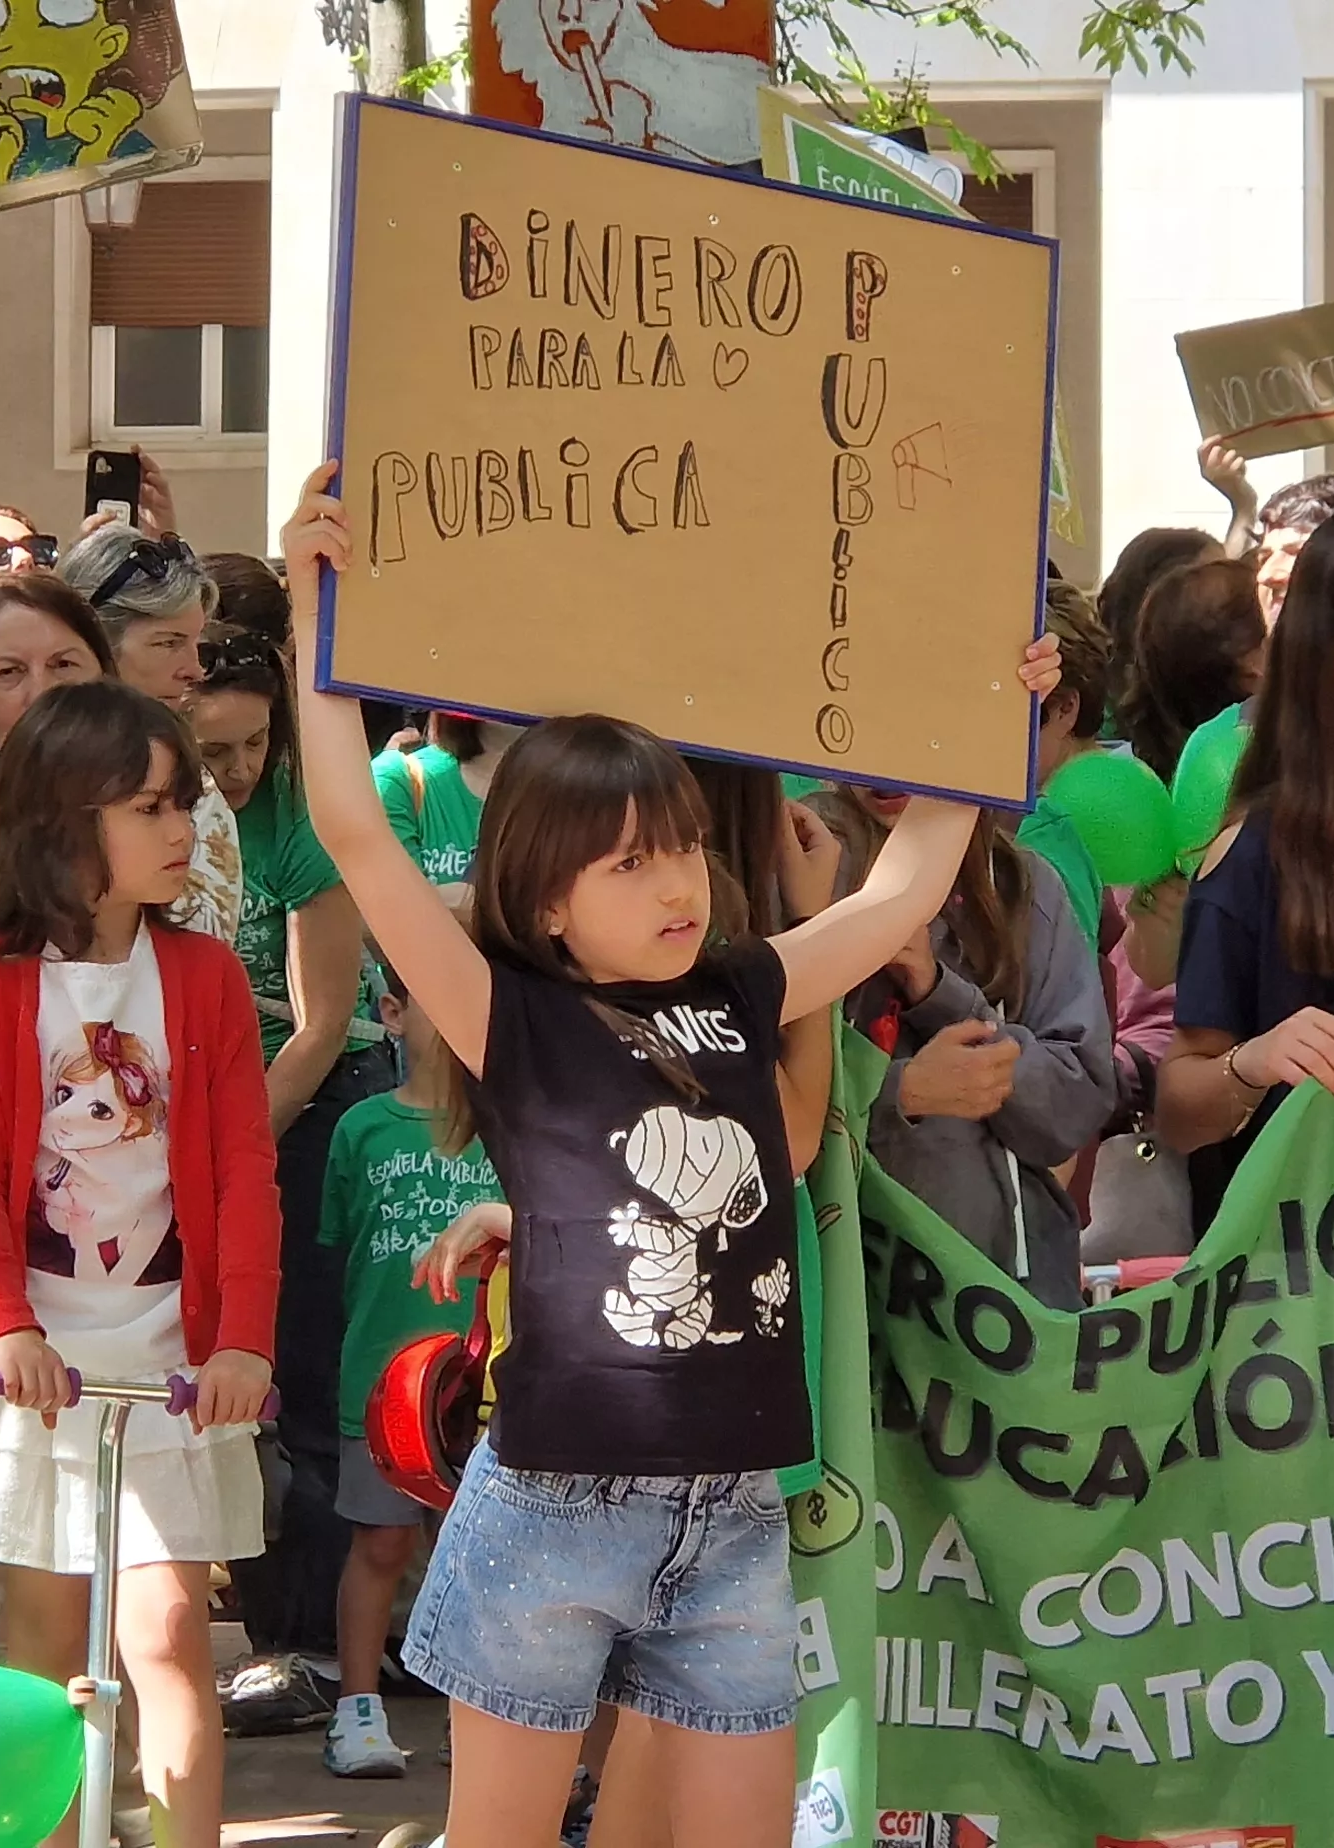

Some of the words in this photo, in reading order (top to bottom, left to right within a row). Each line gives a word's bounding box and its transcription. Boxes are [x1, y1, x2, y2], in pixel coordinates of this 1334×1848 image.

[469, 324, 601, 391] PARA
[617, 331, 686, 388] LA
[1207, 374, 1255, 431] NO
[367, 1150, 434, 1187] ESCUELA
[380, 1199, 406, 1222] DE
[916, 1512, 995, 1606] A
[878, 1811, 923, 1837] CGT
